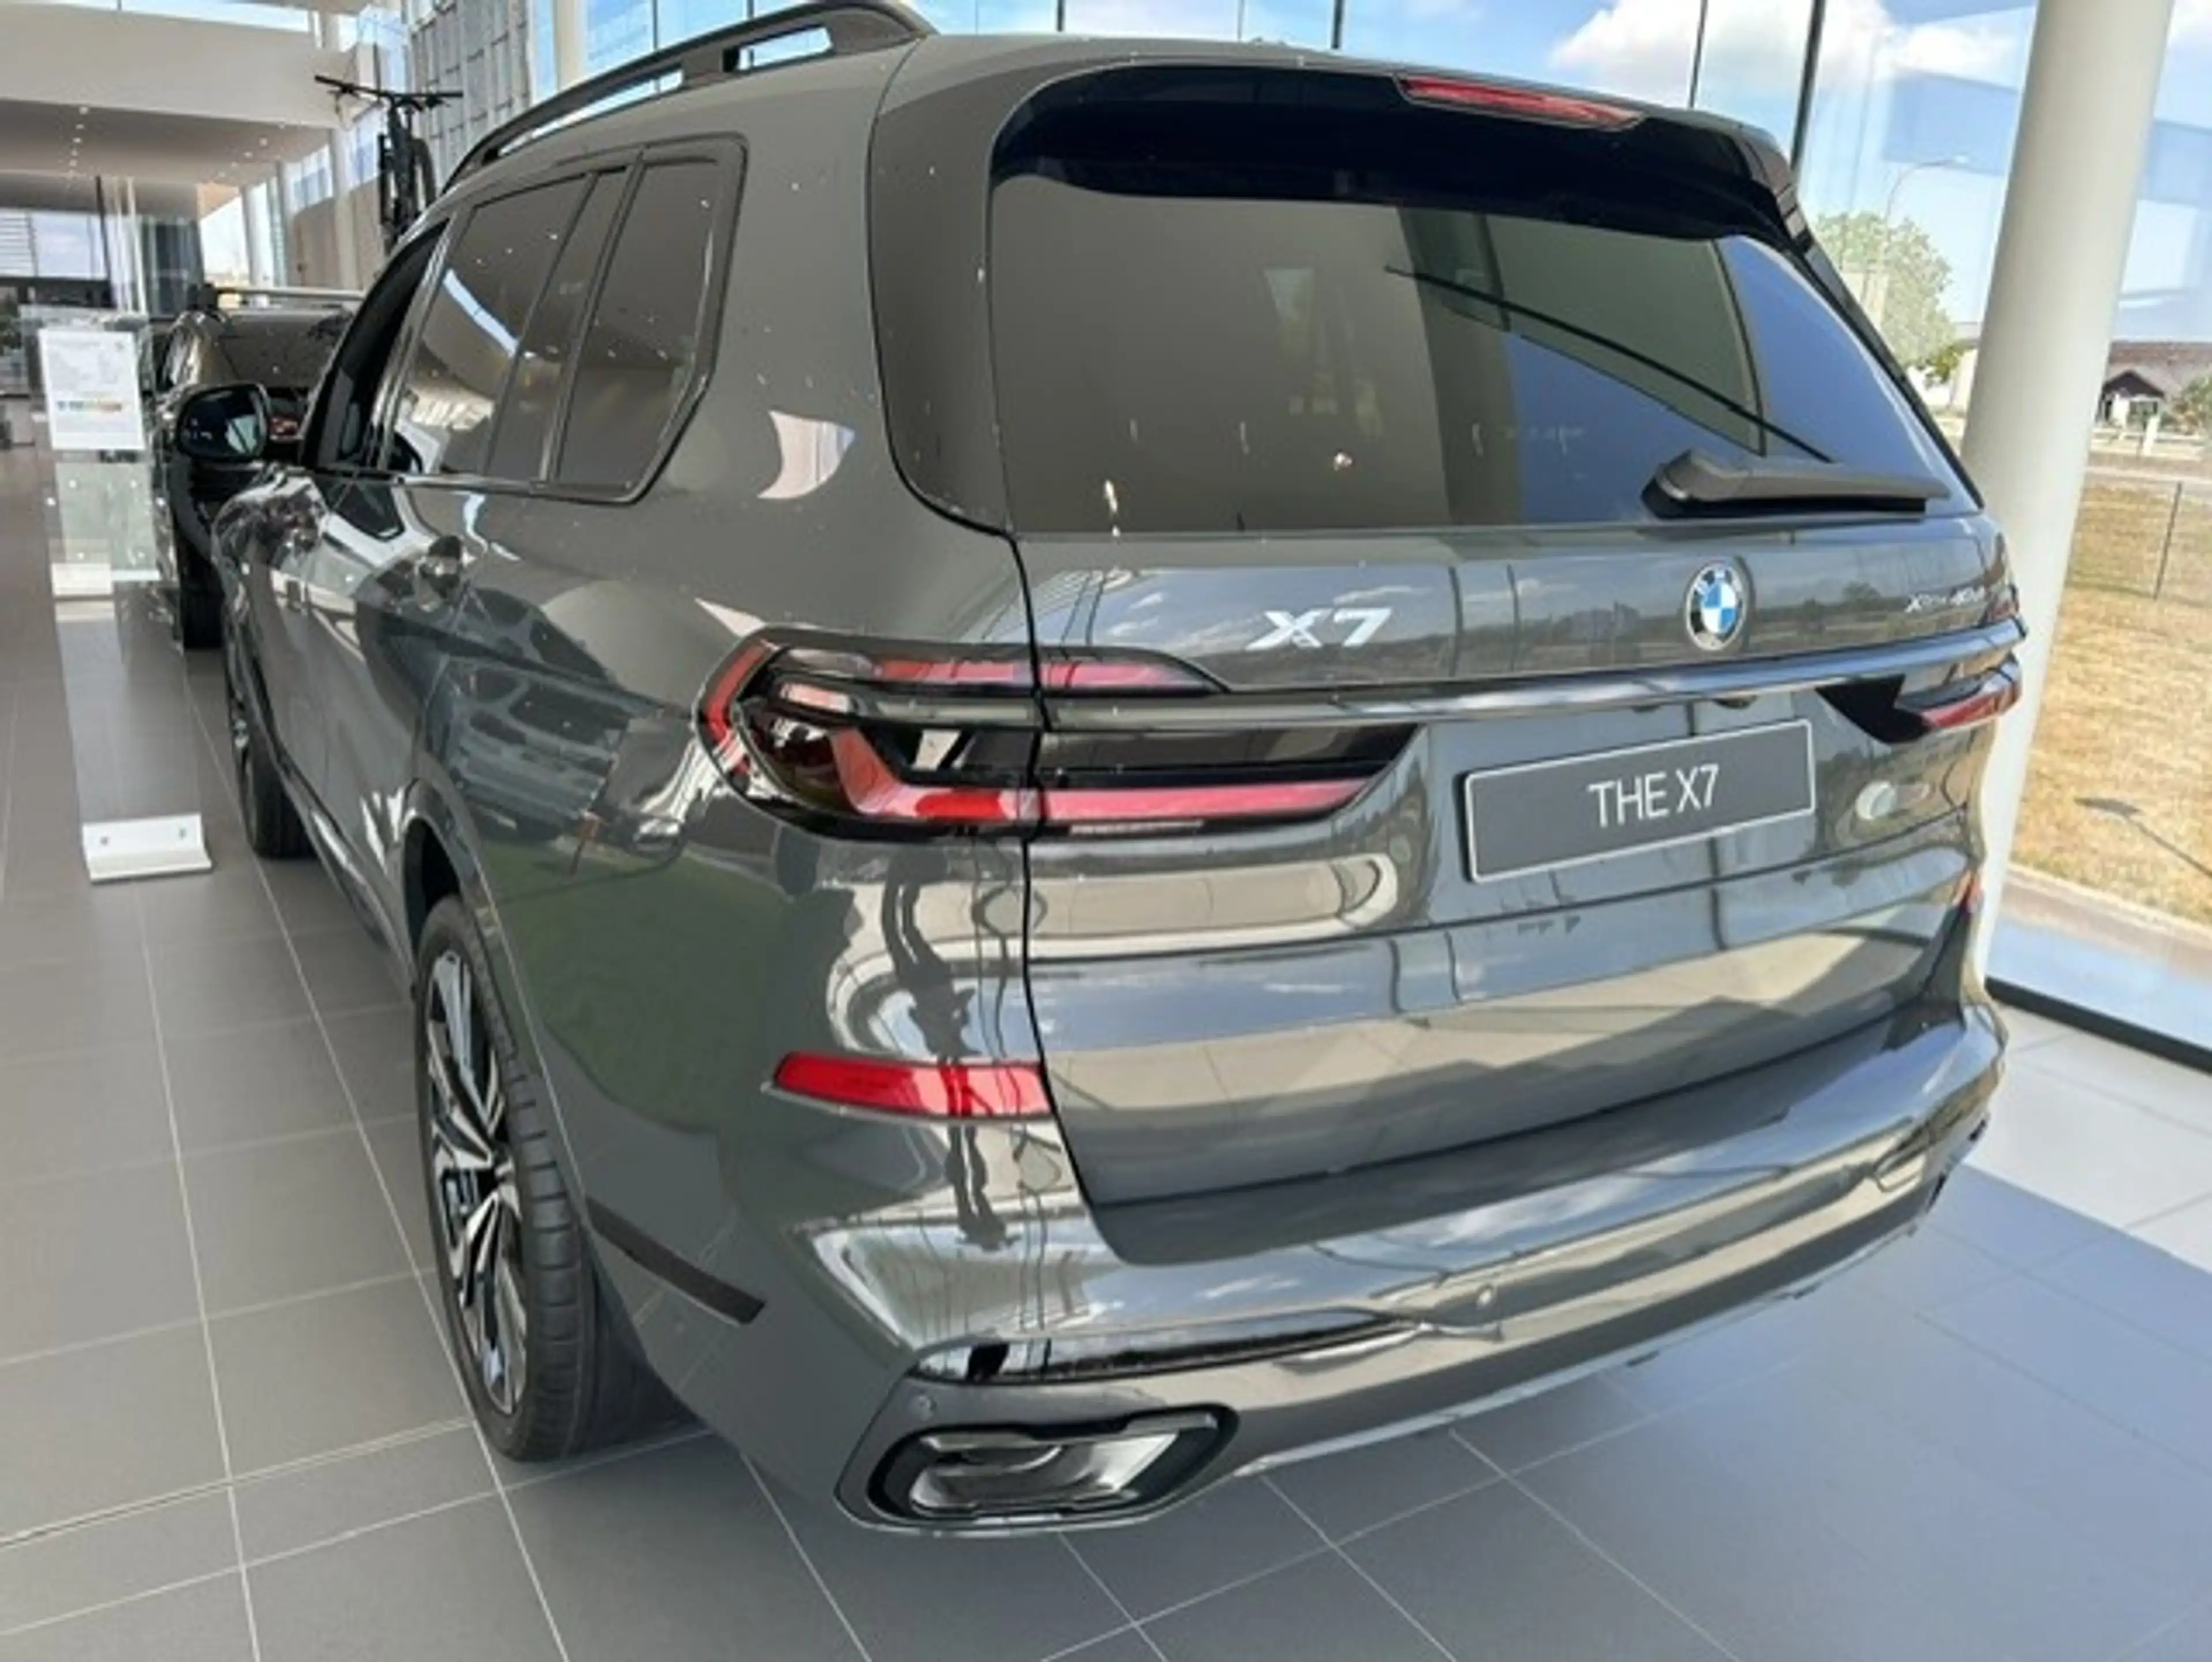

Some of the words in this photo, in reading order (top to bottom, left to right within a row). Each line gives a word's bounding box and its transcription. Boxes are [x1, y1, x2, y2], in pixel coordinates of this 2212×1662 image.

[1245, 608, 1391, 651] X7
[1587, 772, 1669, 828] THE
[1676, 762, 1719, 813] X7
